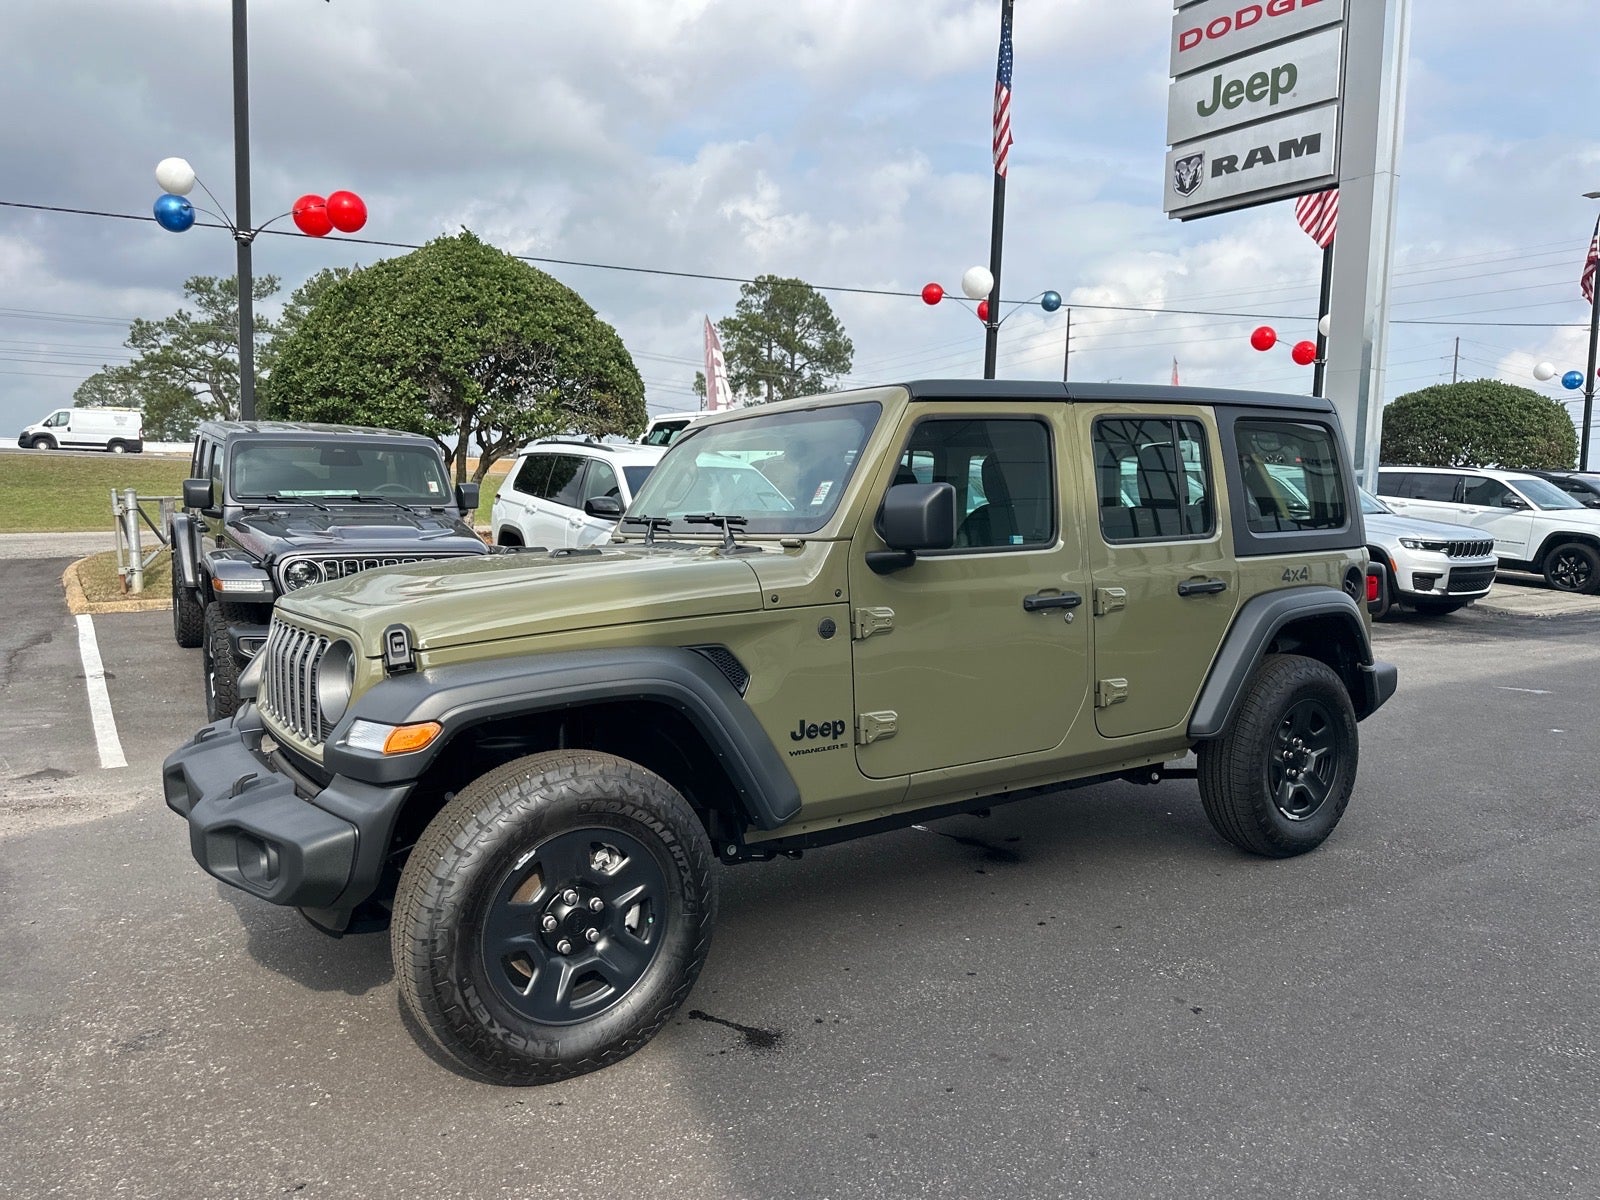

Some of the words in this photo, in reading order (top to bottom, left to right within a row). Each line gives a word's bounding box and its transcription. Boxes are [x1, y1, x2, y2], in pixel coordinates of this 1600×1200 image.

[1196, 62, 1298, 117] Jeep
[1210, 132, 1322, 179] RAM
[1281, 566, 1309, 582] 4x4
[790, 719, 846, 741] Jeep
[788, 744, 840, 757] WRANGLER
[463, 985, 547, 1058] NEXEN
